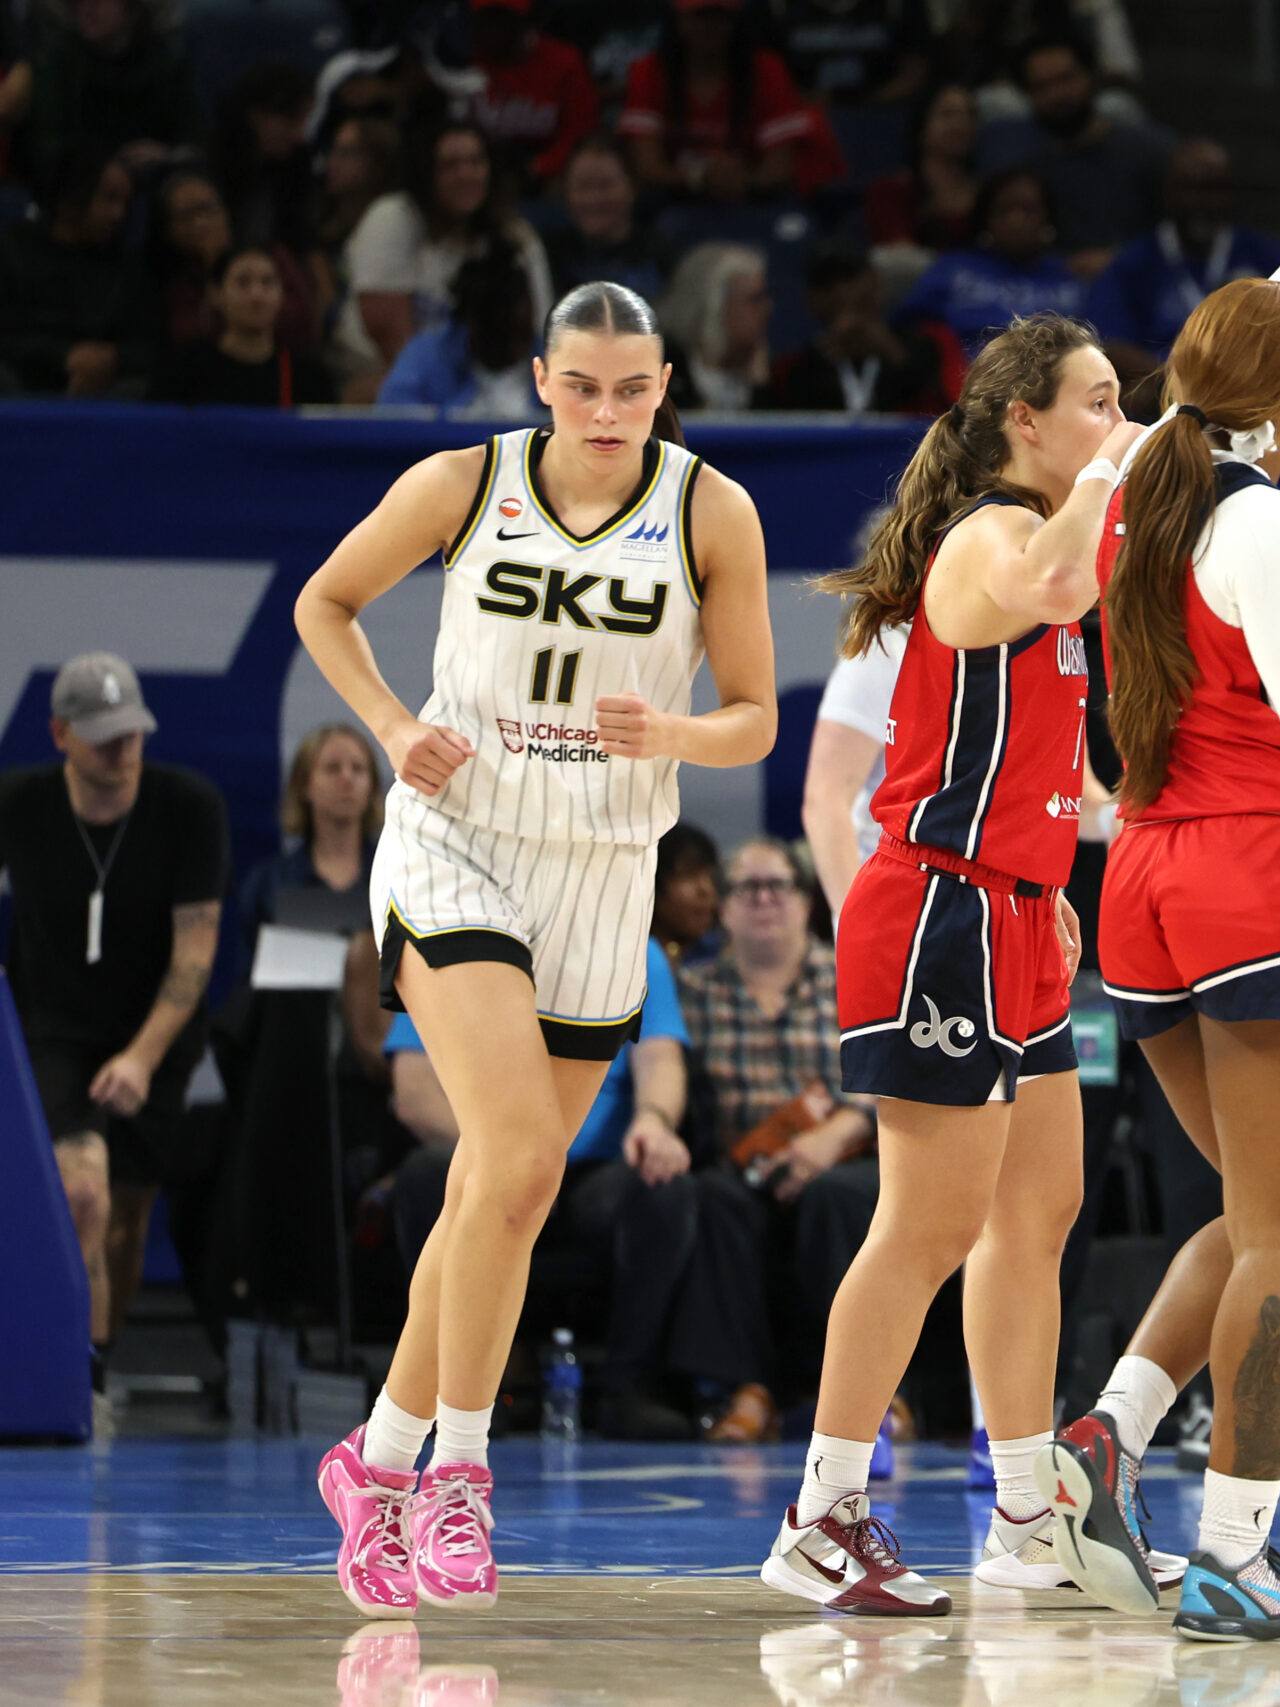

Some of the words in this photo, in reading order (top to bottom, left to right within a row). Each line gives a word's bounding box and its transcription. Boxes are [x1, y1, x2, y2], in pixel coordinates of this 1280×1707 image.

[474, 559, 671, 638] SKY
[528, 644, 584, 706] 11
[525, 722, 600, 745] UChicag
[527, 743, 610, 763] Medicine
